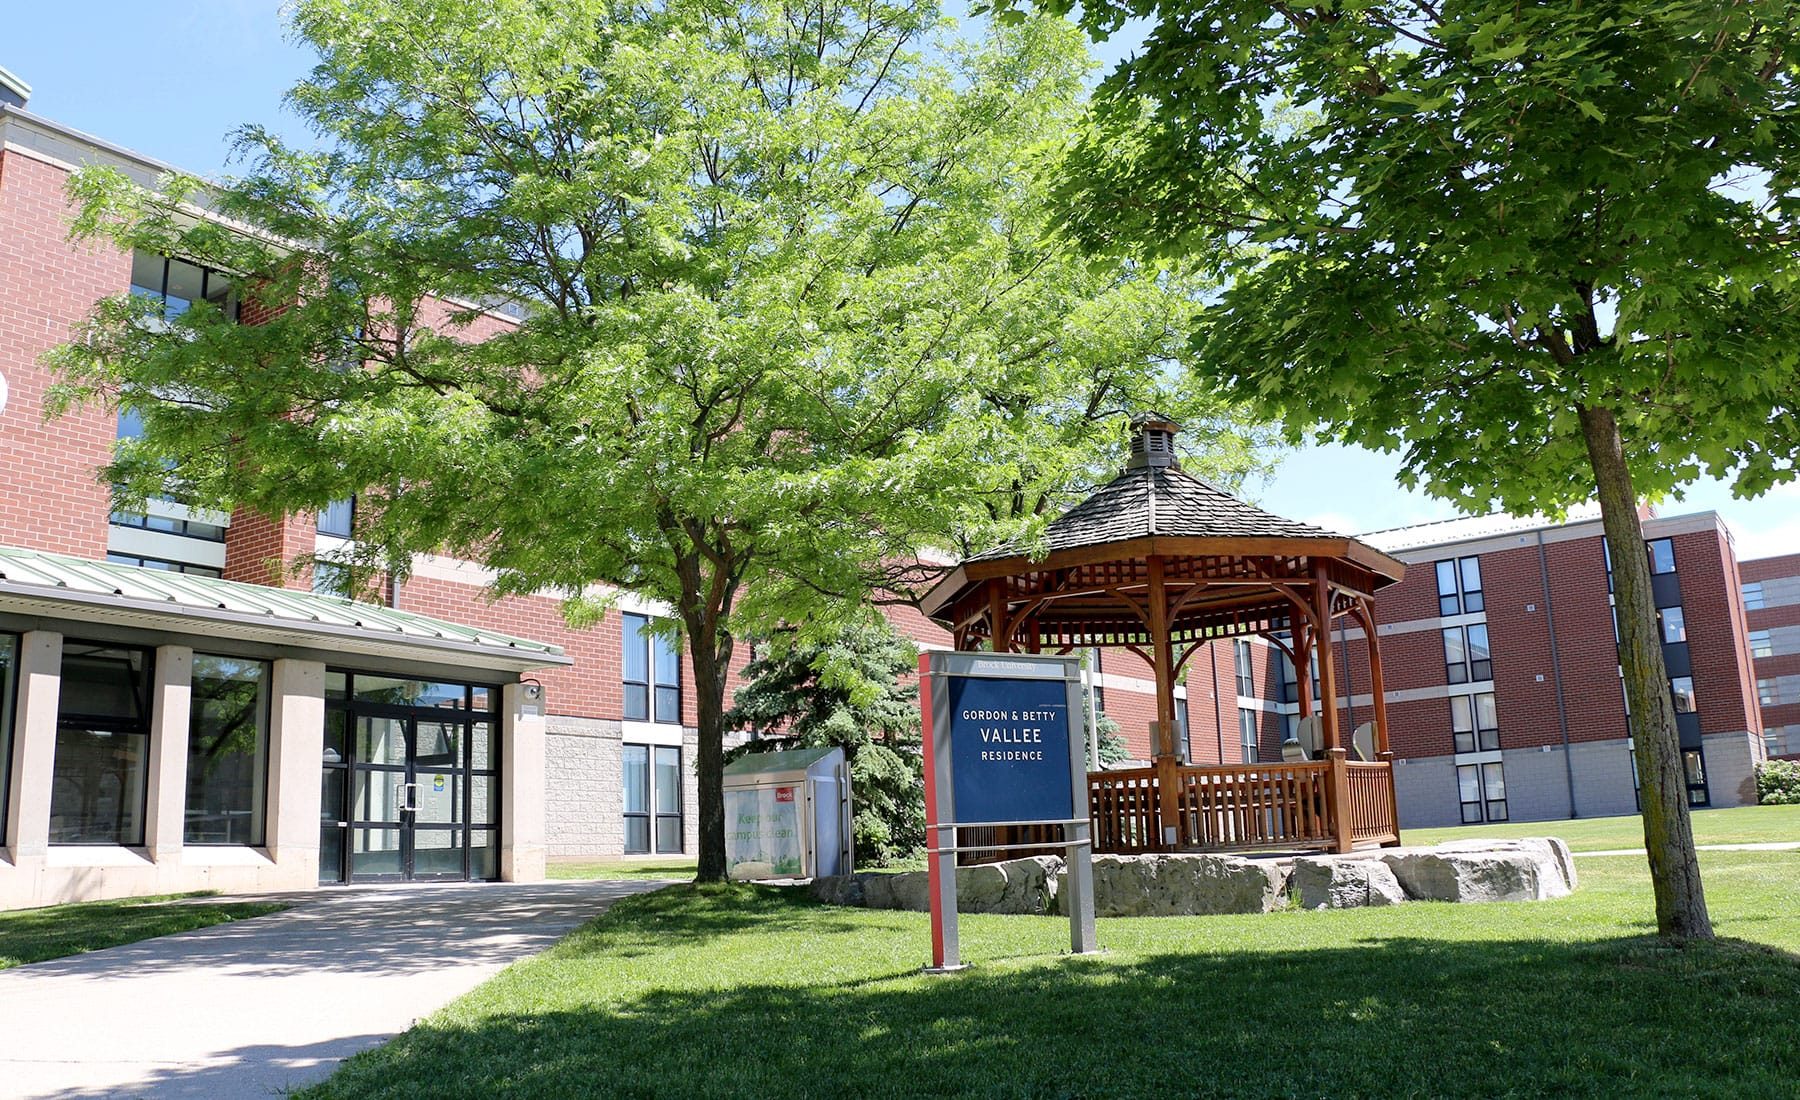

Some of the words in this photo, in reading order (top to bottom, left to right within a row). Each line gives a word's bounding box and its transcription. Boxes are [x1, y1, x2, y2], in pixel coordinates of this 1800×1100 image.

[963, 710, 1008, 720] GORDON
[1011, 711, 1019, 720] &
[1022, 711, 1056, 721] BETTY
[980, 728, 1042, 743] VALLEE
[981, 751, 1043, 761] RESIDENCE
